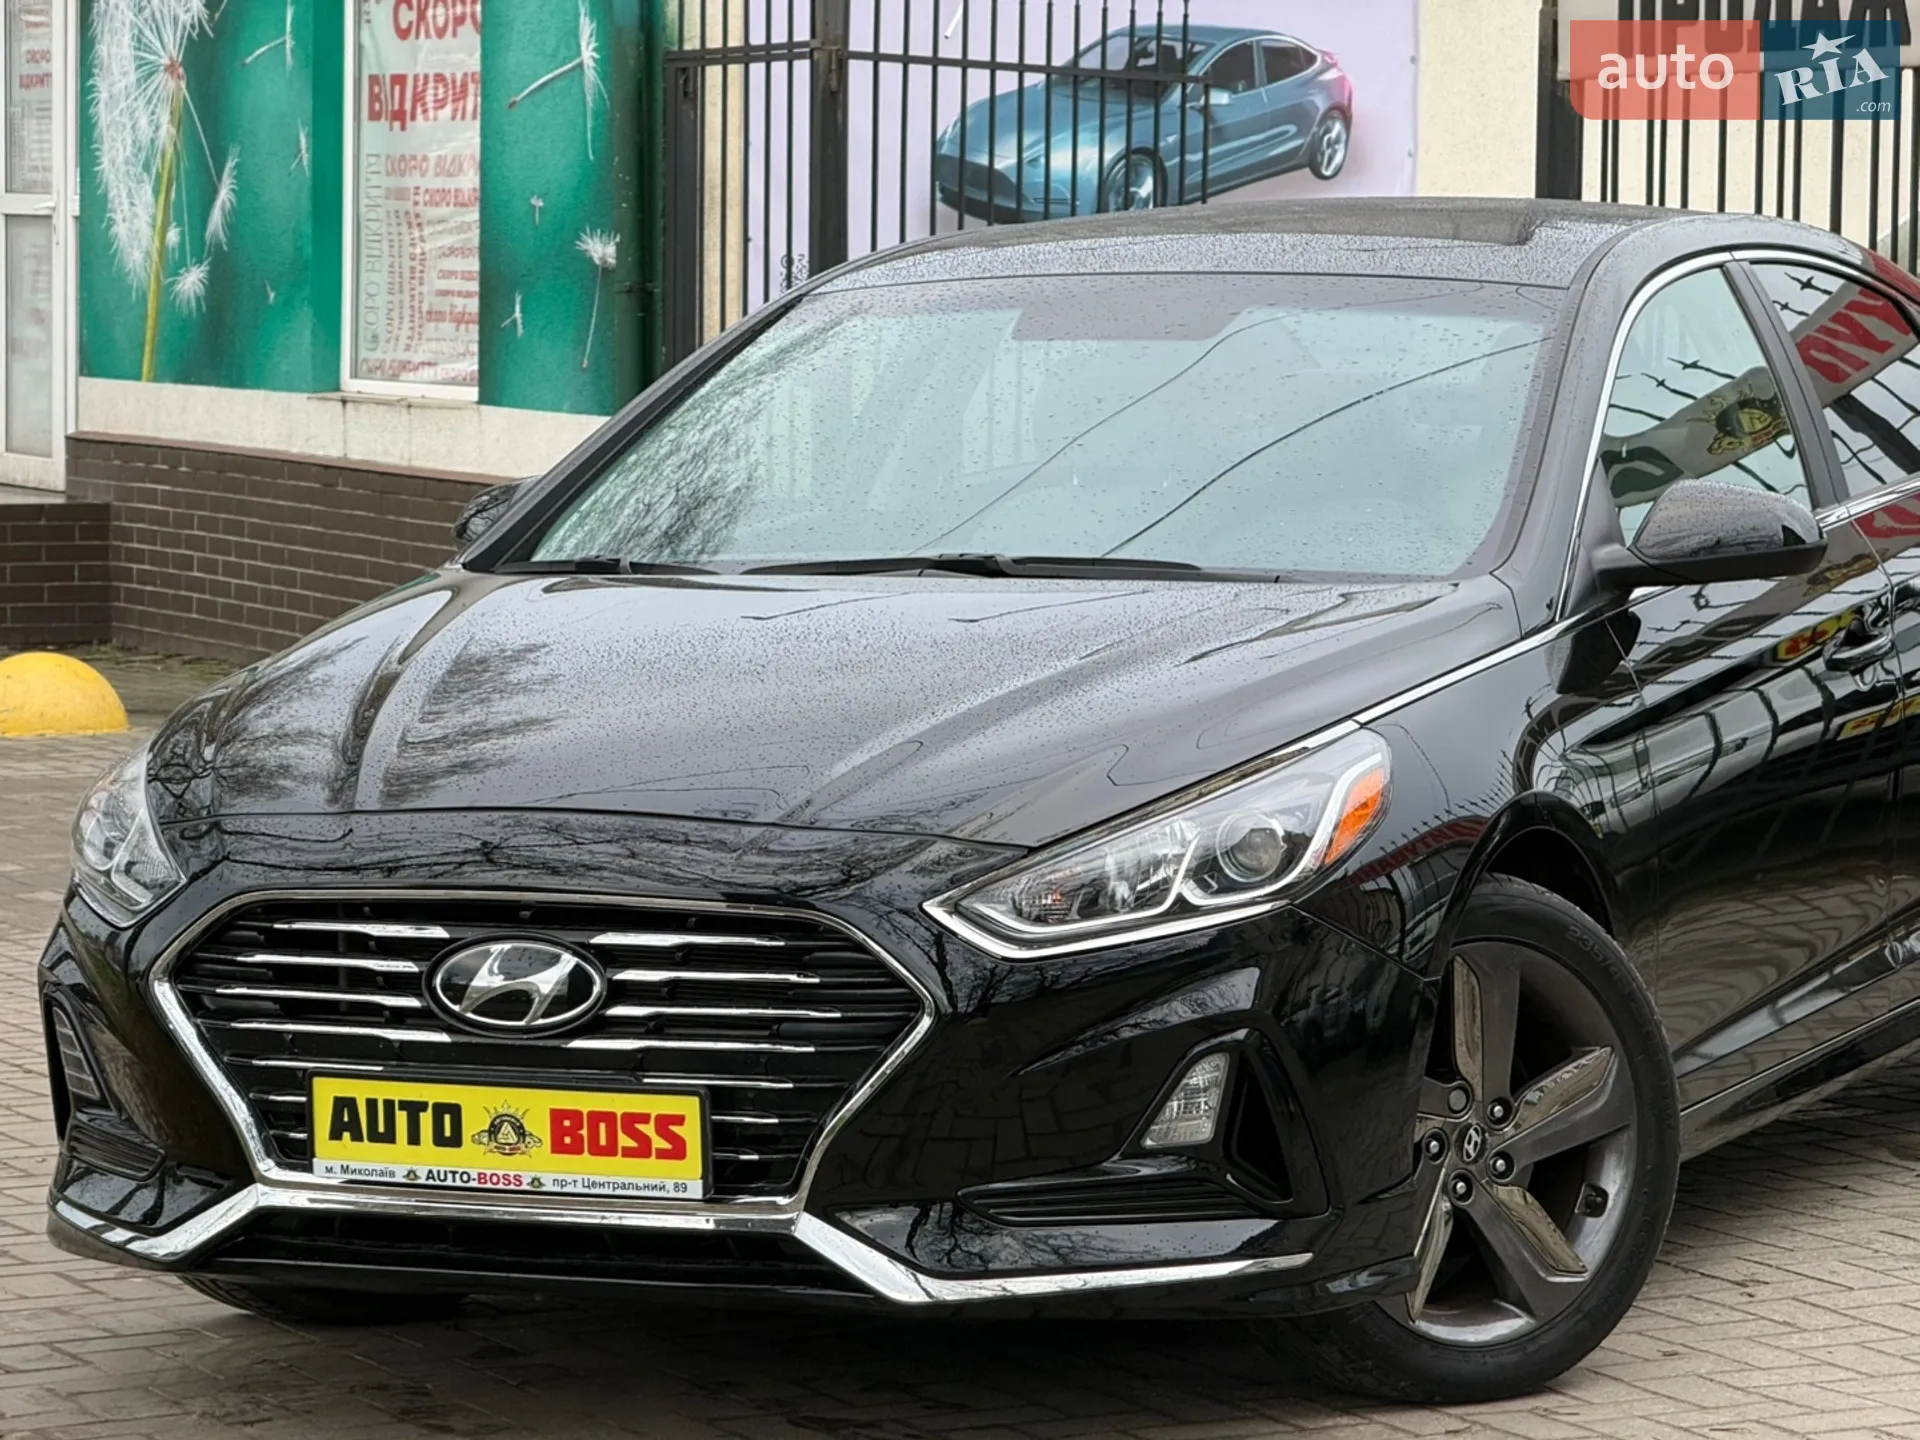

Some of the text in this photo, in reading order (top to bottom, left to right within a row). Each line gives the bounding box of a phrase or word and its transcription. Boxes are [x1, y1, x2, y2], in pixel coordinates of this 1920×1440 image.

[328, 1096, 687, 1161] AUTO BOSS
[324, 1164, 396, 1179] м. Миколаїв
[425, 1168, 524, 1188] AUTO-BOSS
[551, 1177, 688, 1194] пр-т Центральний, 89
